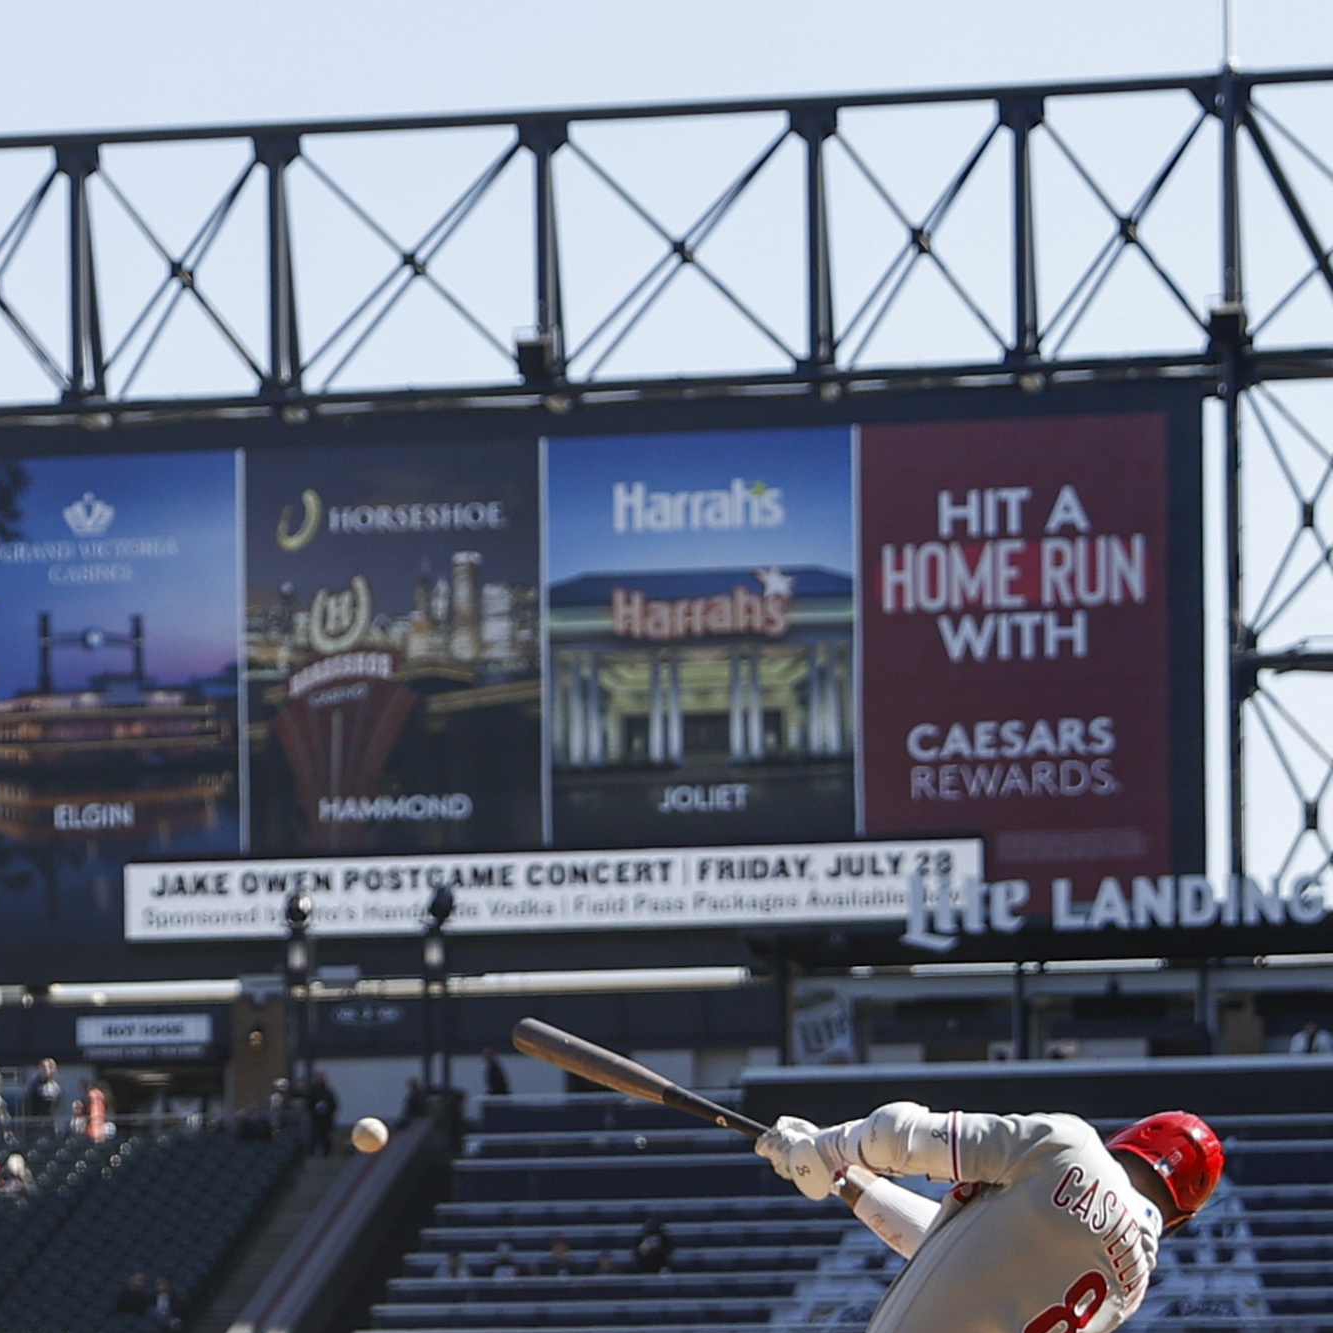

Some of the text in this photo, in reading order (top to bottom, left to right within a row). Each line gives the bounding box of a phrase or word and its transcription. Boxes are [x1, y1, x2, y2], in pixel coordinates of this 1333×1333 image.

[328, 501, 508, 533] HORSESHOE
[937, 484, 1091, 539] HIT A
[881, 532, 1146, 614] HOME RUN
[937, 609, 1088, 663] WITH
[906, 715, 1116, 763] CAESARS
[53, 802, 134, 830] ELGIN
[318, 793, 473, 822] HAMMOND
[658, 783, 751, 814] JOLIET
[152, 852, 952, 897] JAKE OWEN POSTGAME CONCERT FRIDAY, JULY 28
[899, 872, 1329, 950] Lite LANDING
